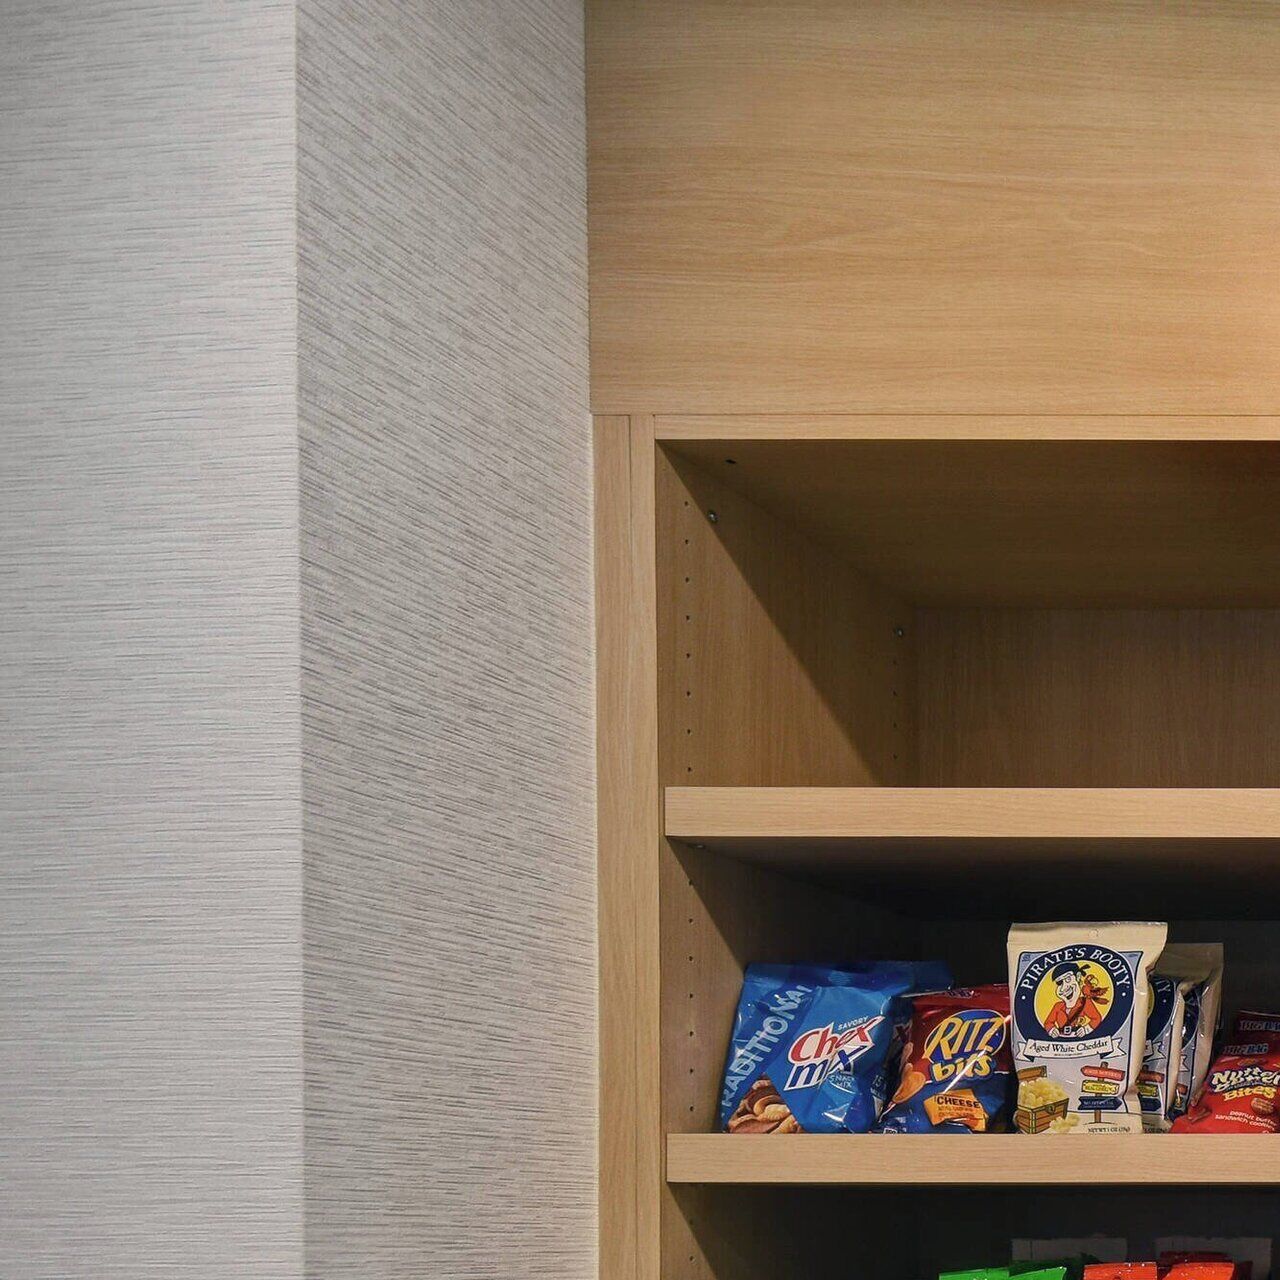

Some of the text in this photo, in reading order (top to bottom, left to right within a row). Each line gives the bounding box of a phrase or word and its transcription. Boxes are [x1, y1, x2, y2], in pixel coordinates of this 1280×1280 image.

[1022, 947, 1132, 990] PIRATE'S BOOTY
[838, 1015, 869, 1031] SAVORY
[925, 1013, 1004, 1062] RITZ
[1222, 1084, 1277, 1102] Bites
